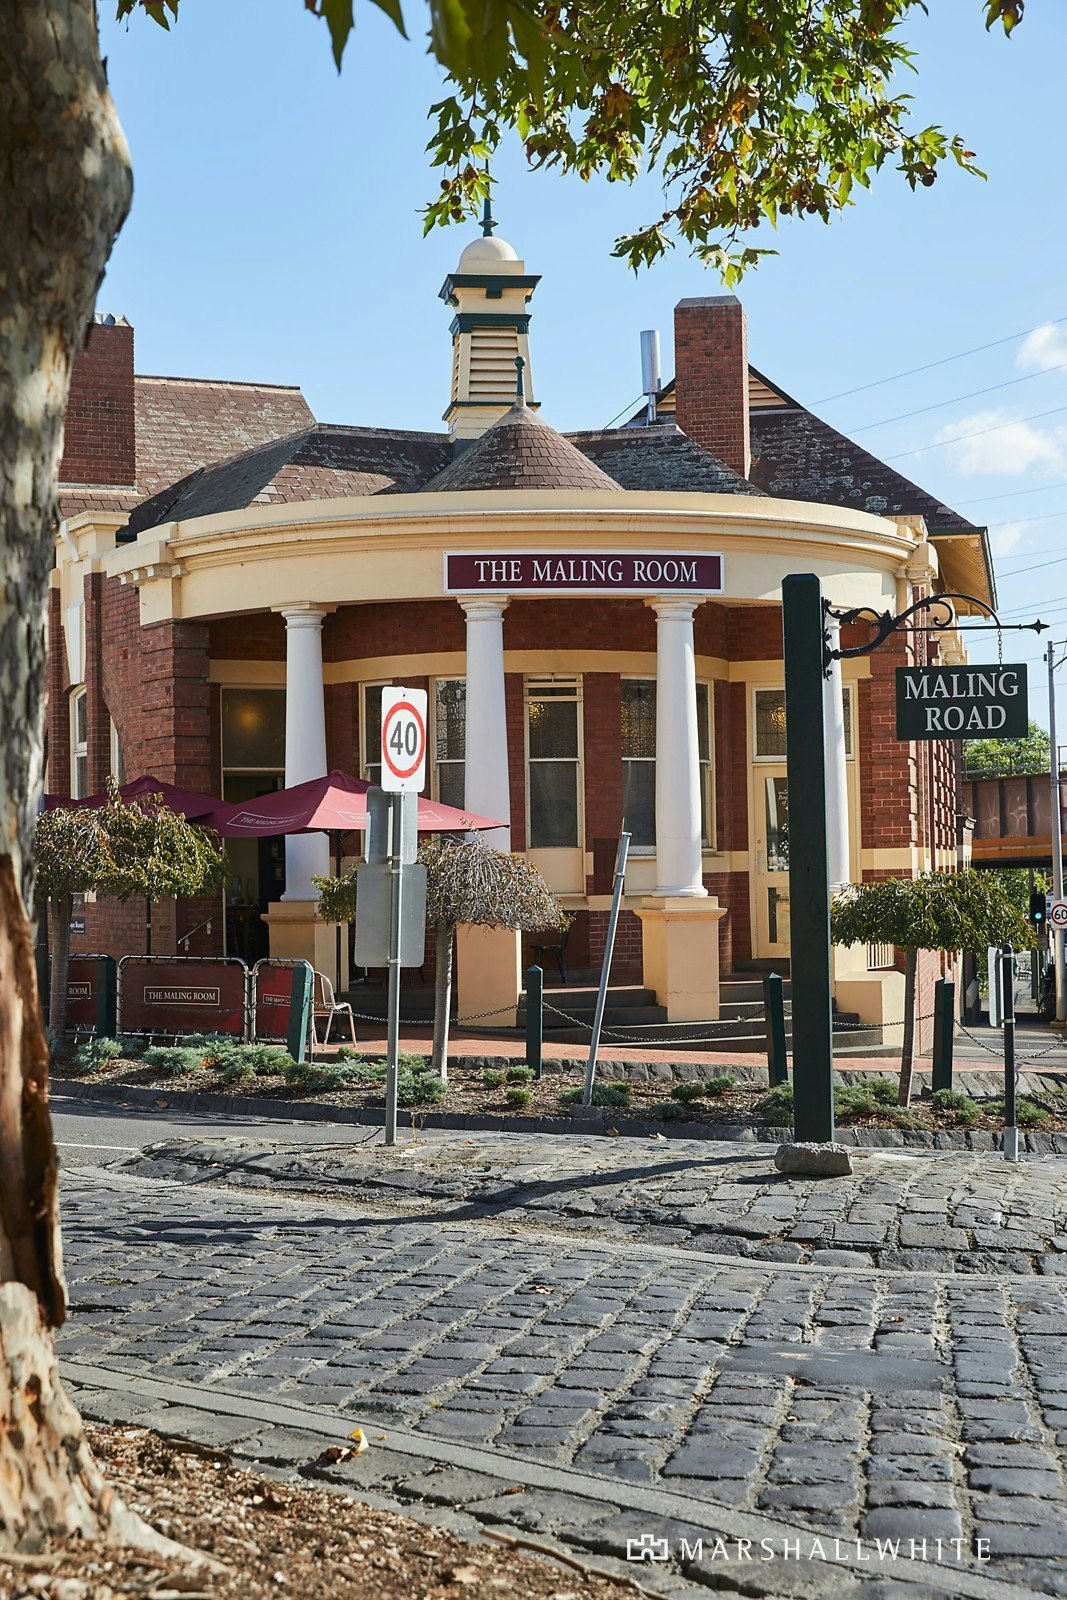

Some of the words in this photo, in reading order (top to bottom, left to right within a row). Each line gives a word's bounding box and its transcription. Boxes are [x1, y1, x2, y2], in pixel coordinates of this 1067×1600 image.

[474, 560, 523, 582] THE
[532, 560, 624, 582] MALING
[633, 560, 698, 582] ROOM
[904, 671, 1019, 699] MALING
[925, 705, 1007, 731] ROAD
[390, 720, 418, 756] 40
[1055, 909, 1067, 920] 60
[68, 987, 88, 995] ROOM
[148, 991, 163, 1000] THE
[164, 991, 192, 1000] MALING
[193, 992, 216, 1001] ROOM
